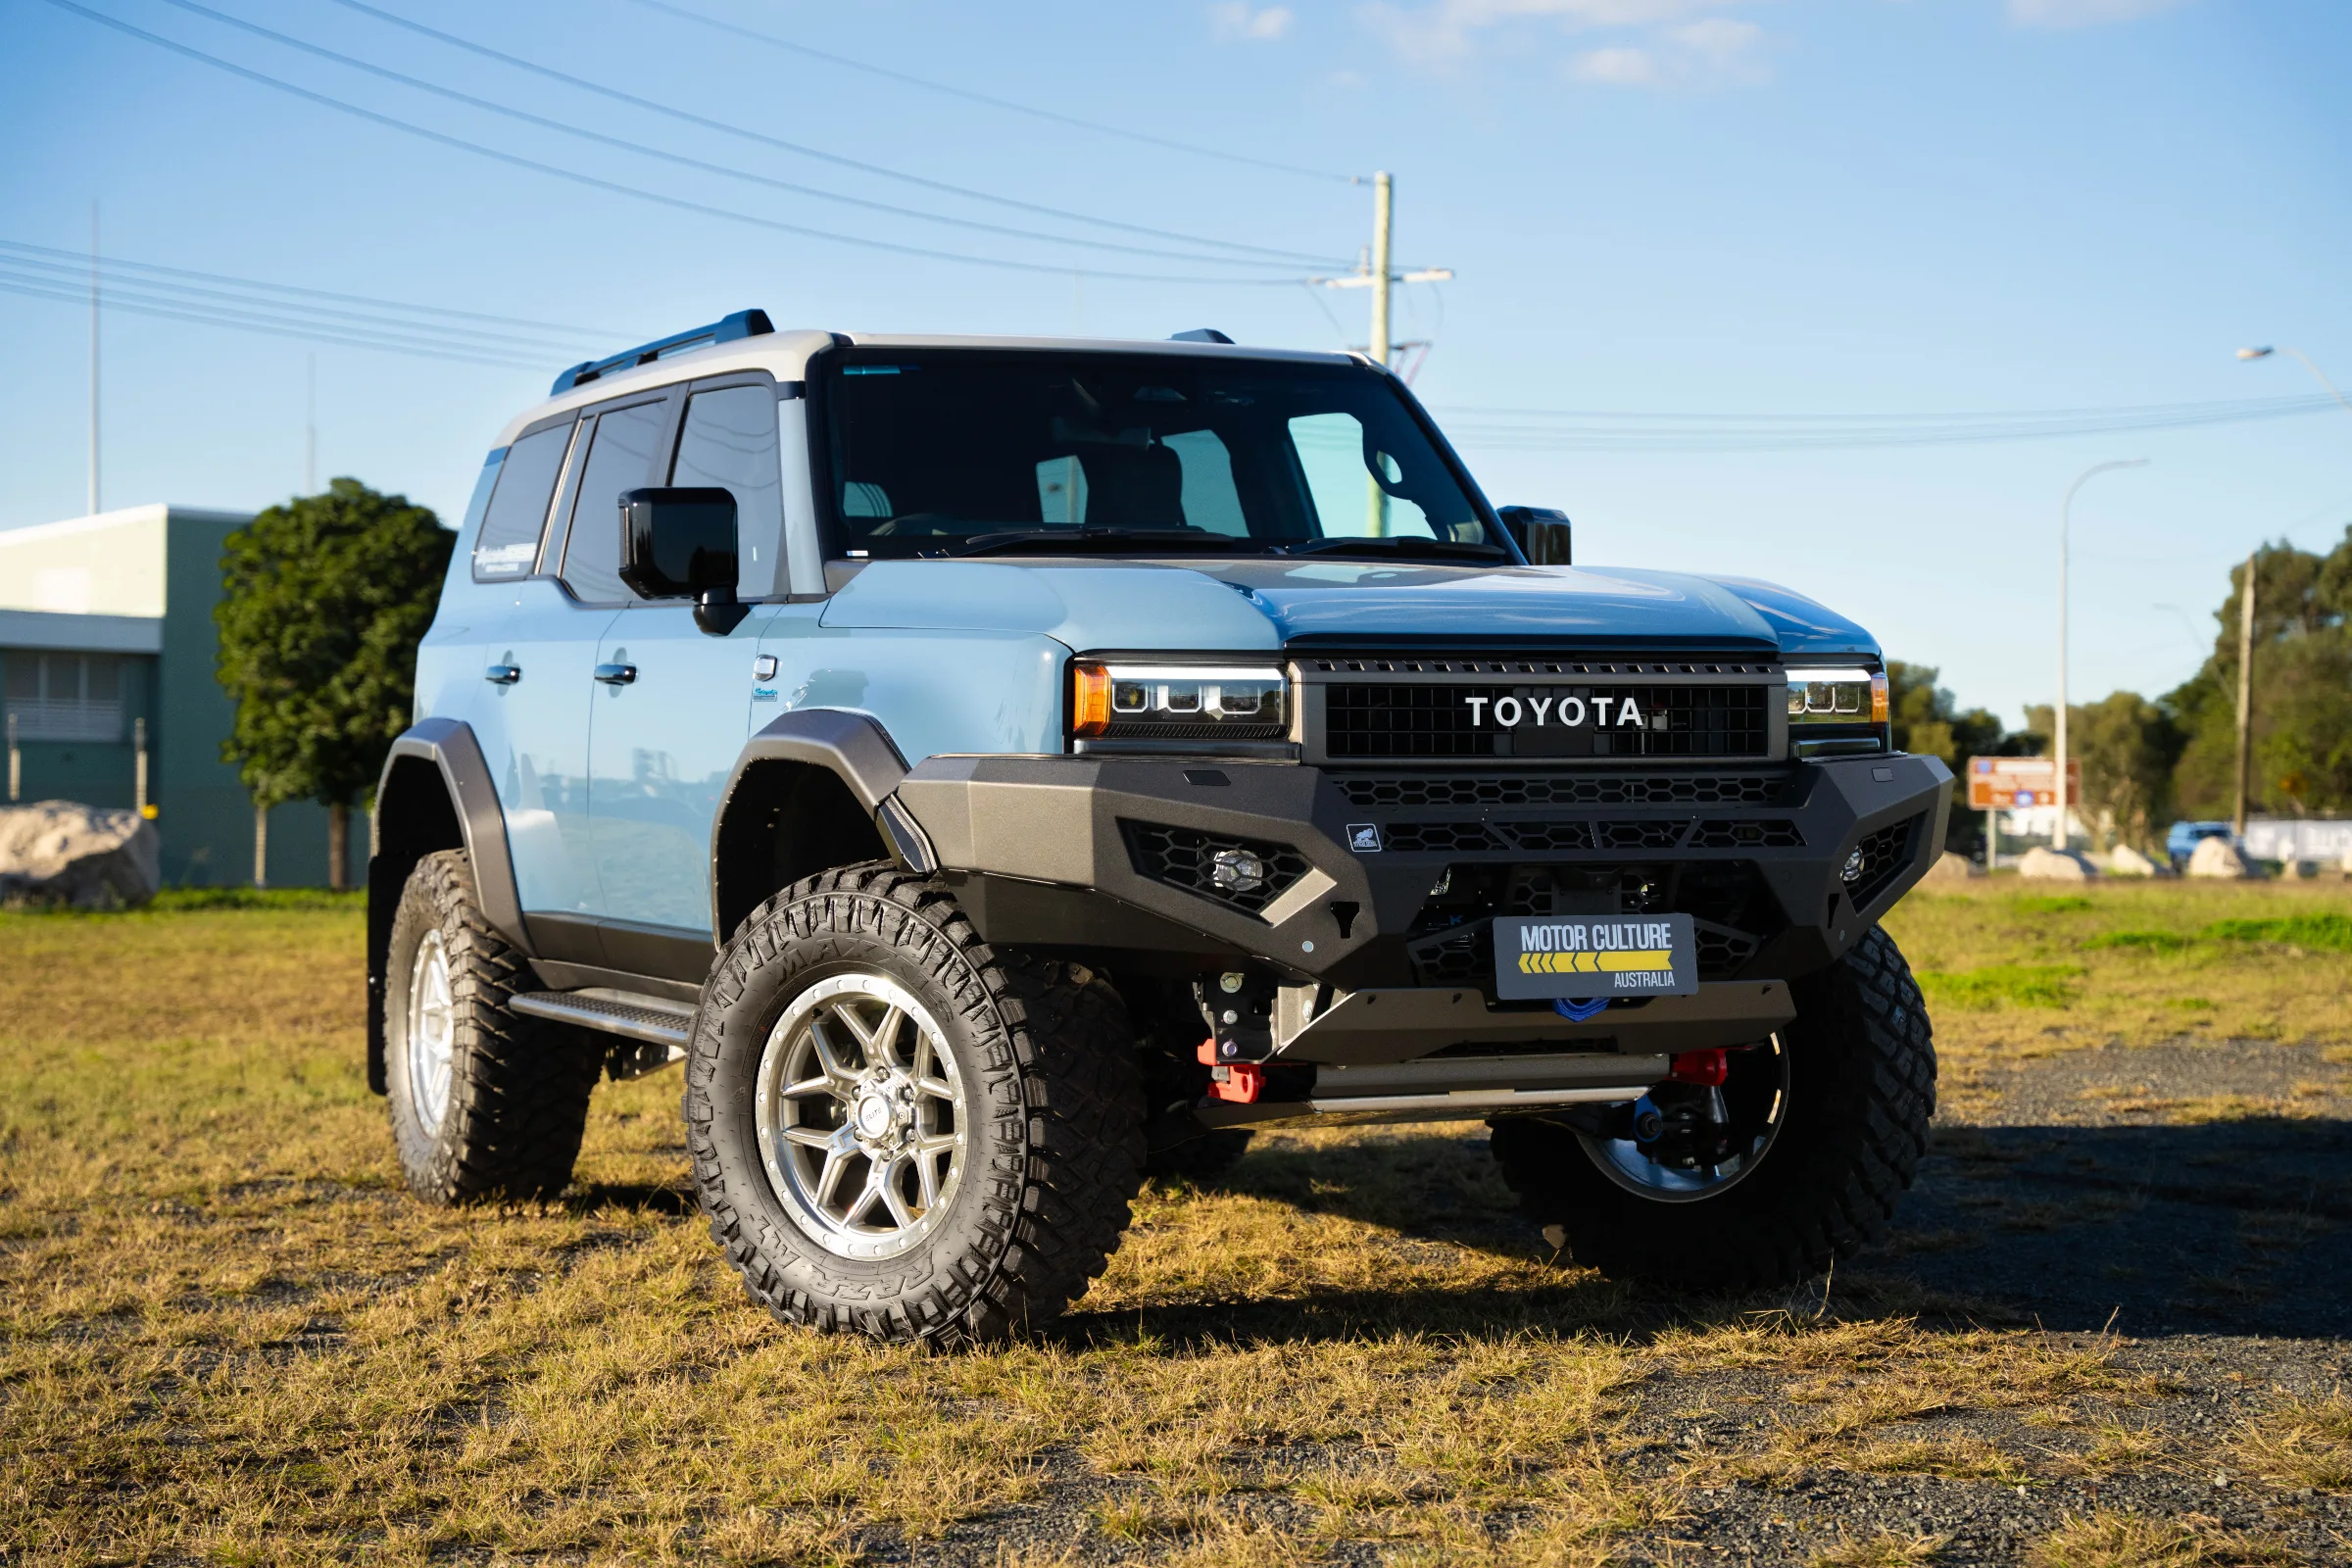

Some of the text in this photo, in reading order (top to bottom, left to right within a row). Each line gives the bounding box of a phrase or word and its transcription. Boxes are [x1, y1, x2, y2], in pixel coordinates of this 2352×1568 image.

[1465, 697, 1643, 727] TOYOTA
[1521, 922, 1673, 952] MOTOR CULTURE
[776, 937, 955, 1024] MAXXIS
[1614, 970, 1676, 989] AUSTRALIA
